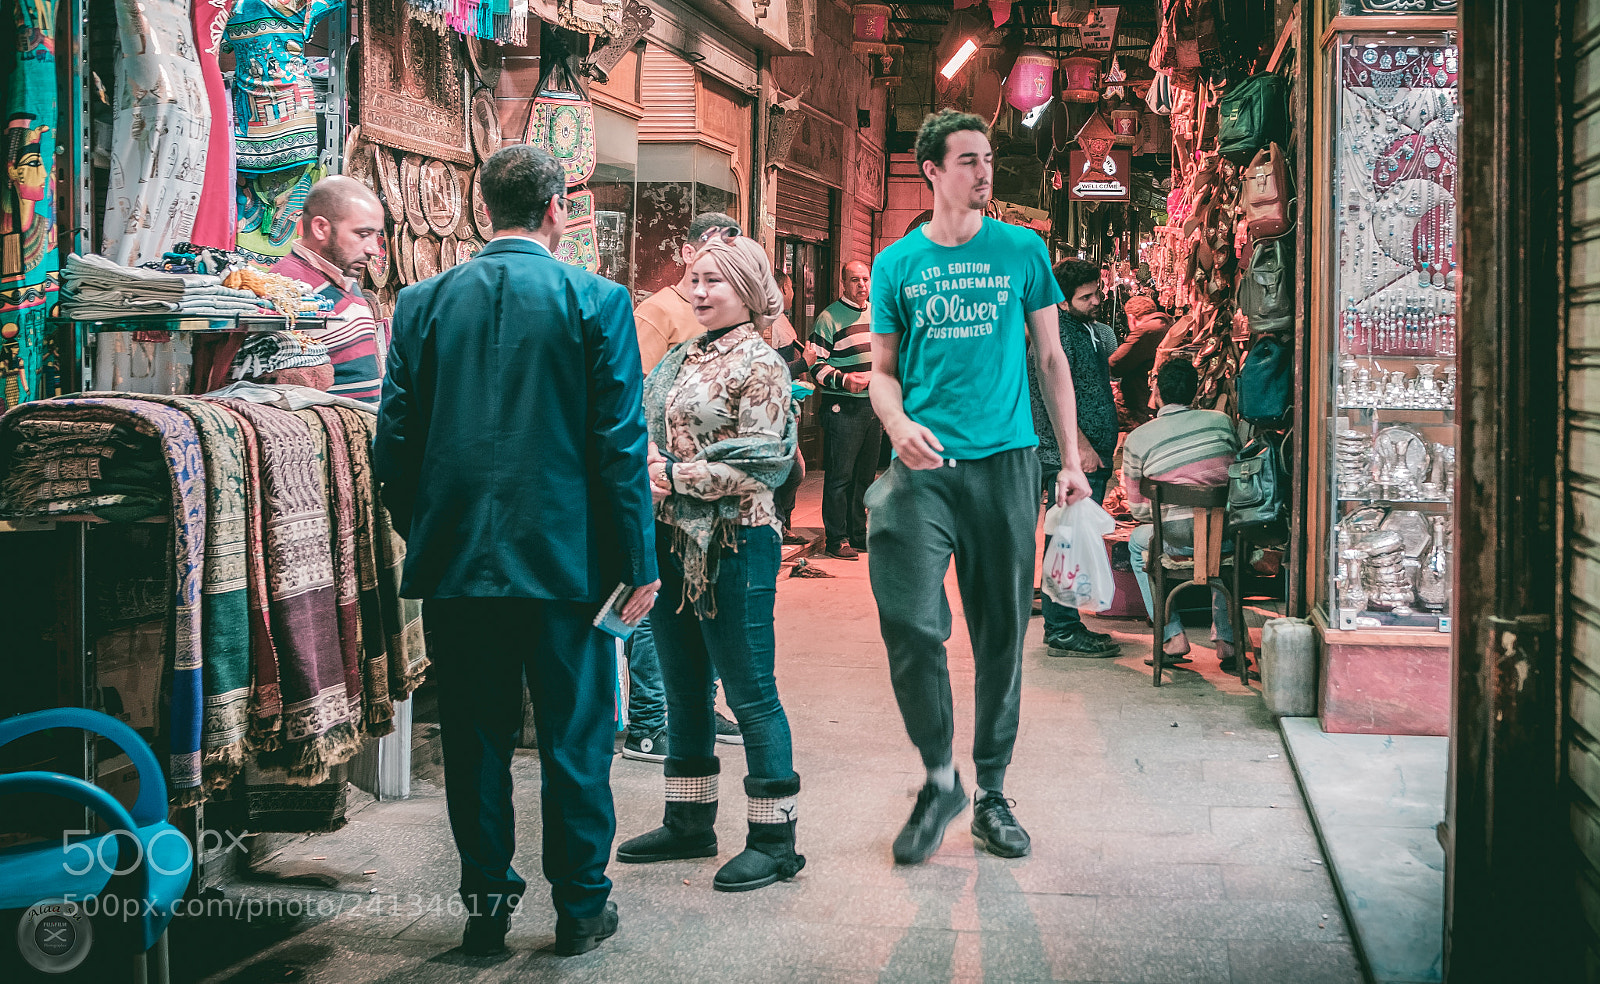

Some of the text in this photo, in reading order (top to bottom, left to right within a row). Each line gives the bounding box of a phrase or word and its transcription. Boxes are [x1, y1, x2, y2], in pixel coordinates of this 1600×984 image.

[921, 262, 991, 281] LTD. EDITION
[904, 275, 1011, 299] REG. TRADEMARK
[926, 322, 993, 339] CUSTOMIZED
